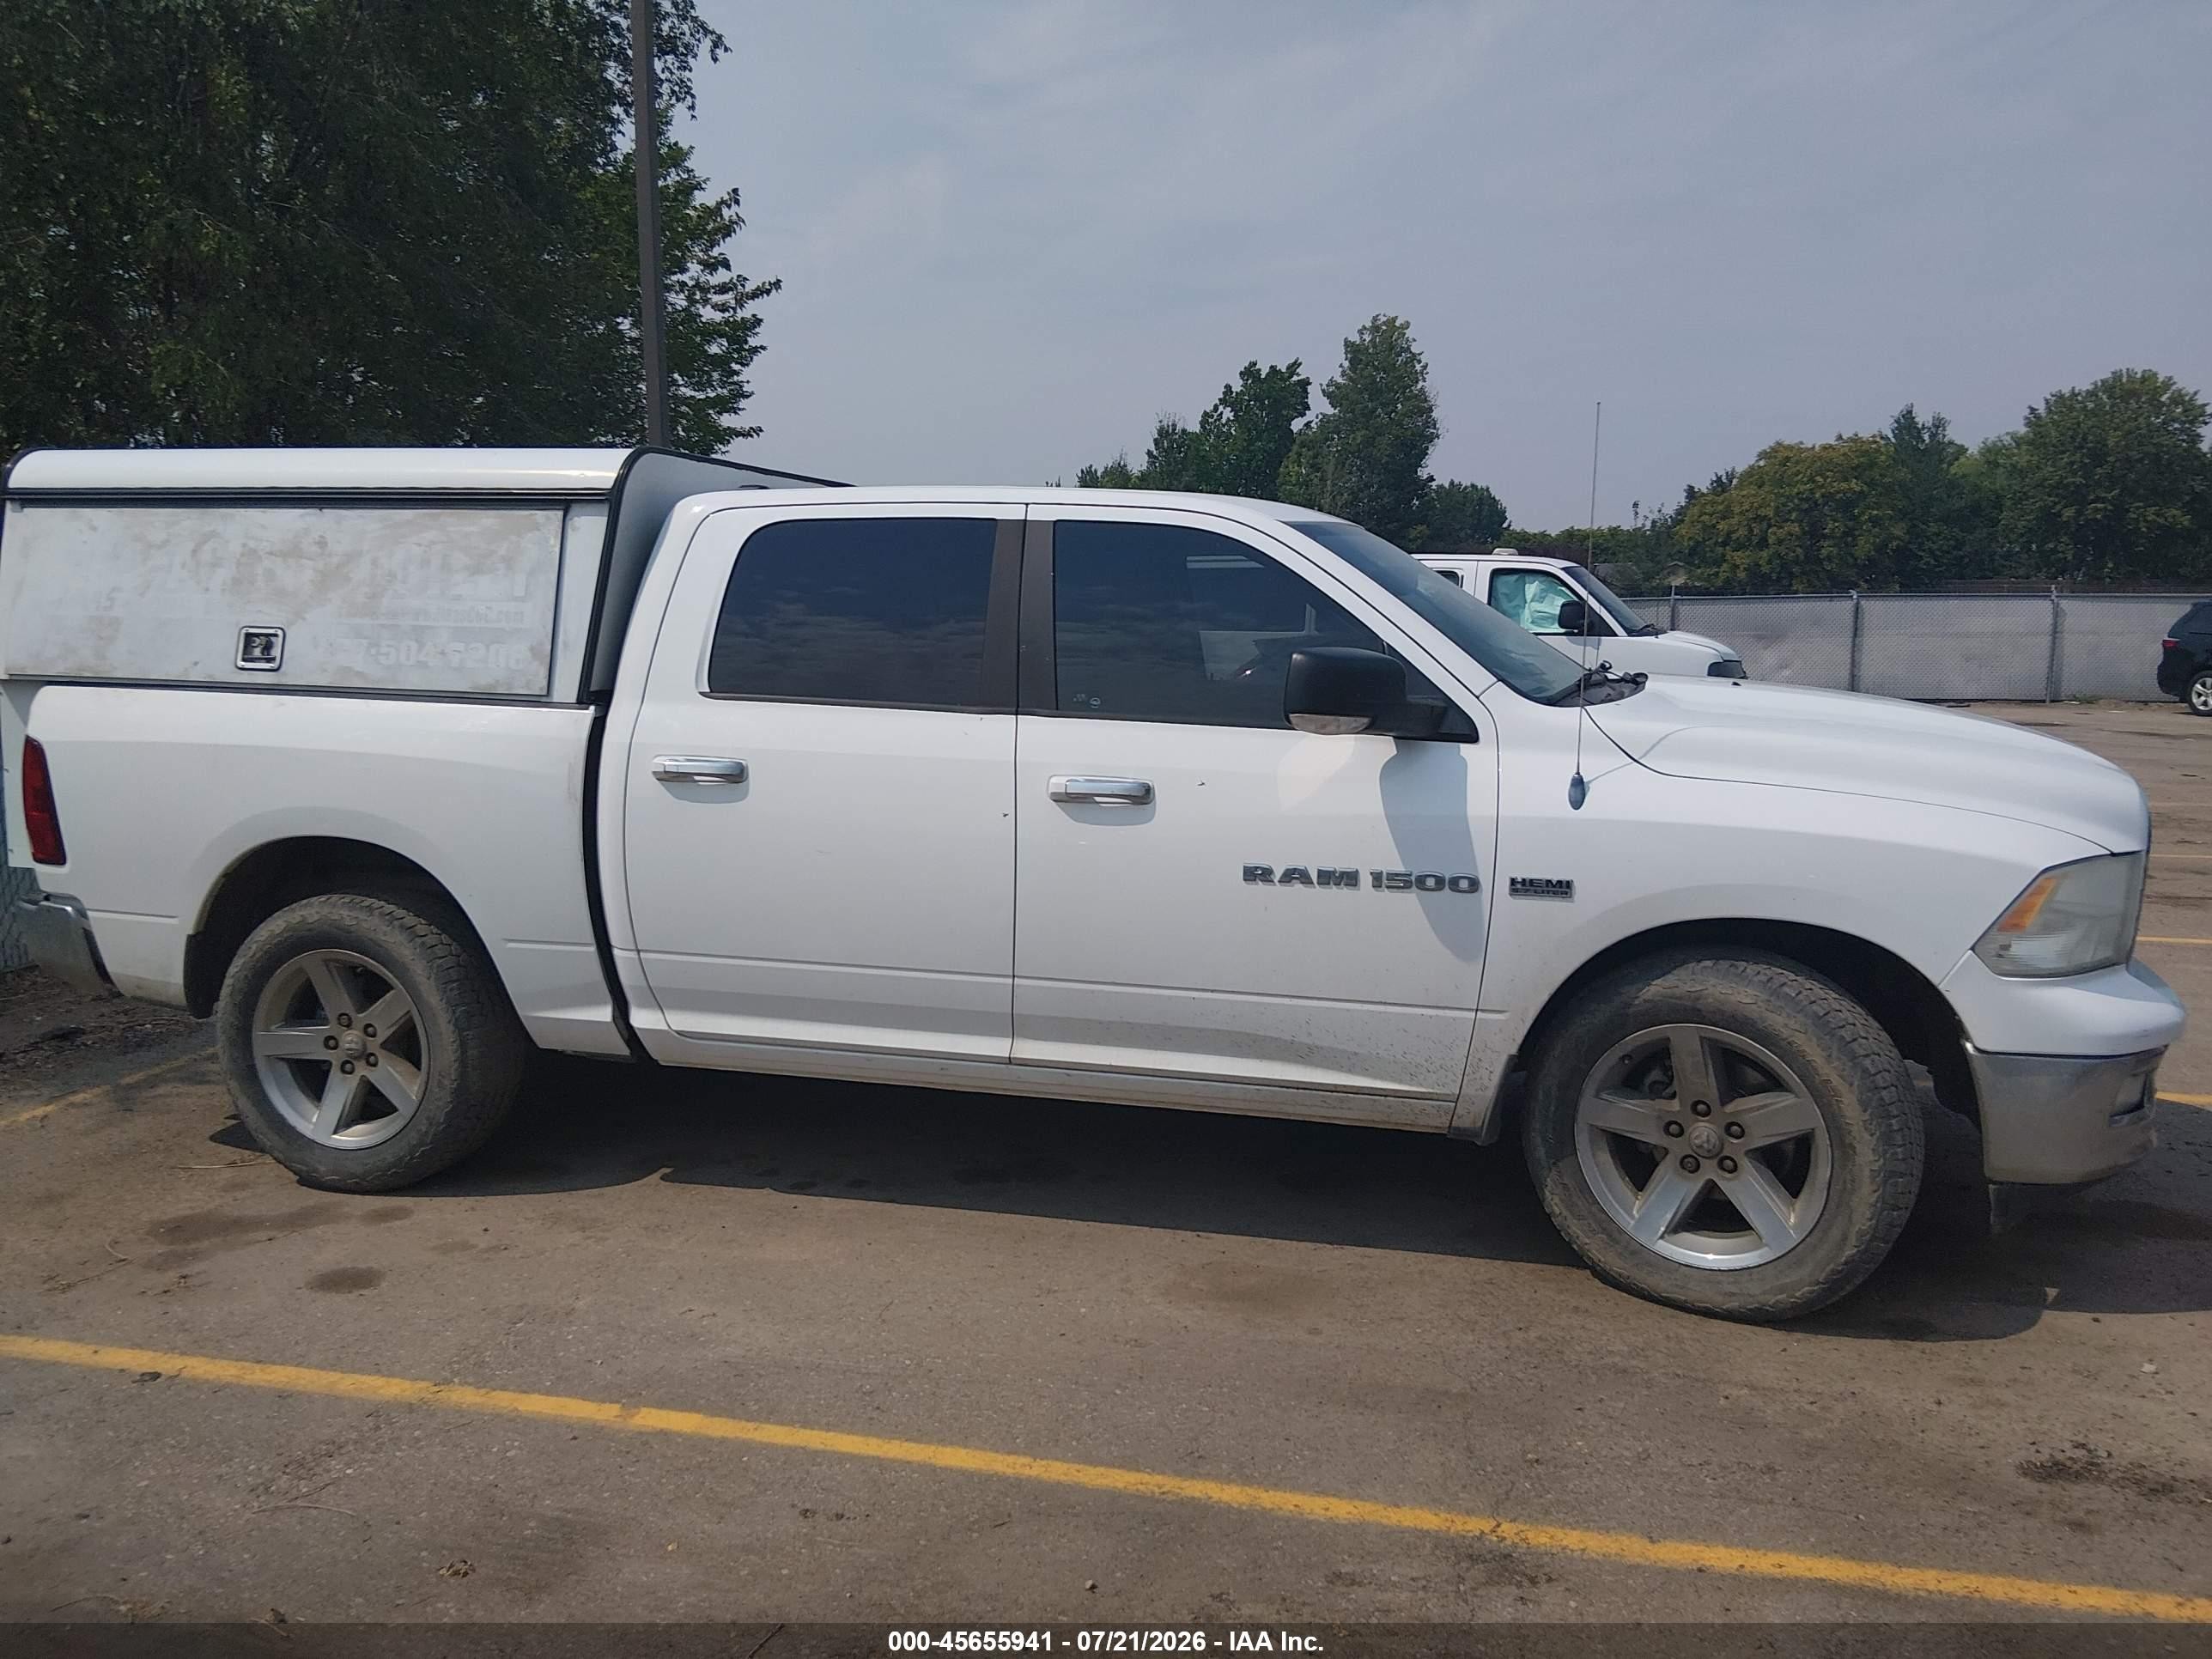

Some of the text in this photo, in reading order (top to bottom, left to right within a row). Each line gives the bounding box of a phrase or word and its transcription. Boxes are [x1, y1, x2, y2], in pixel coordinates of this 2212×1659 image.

[1243, 863, 1480, 894] RAM 1500
[1510, 878, 1573, 890] HEMI
